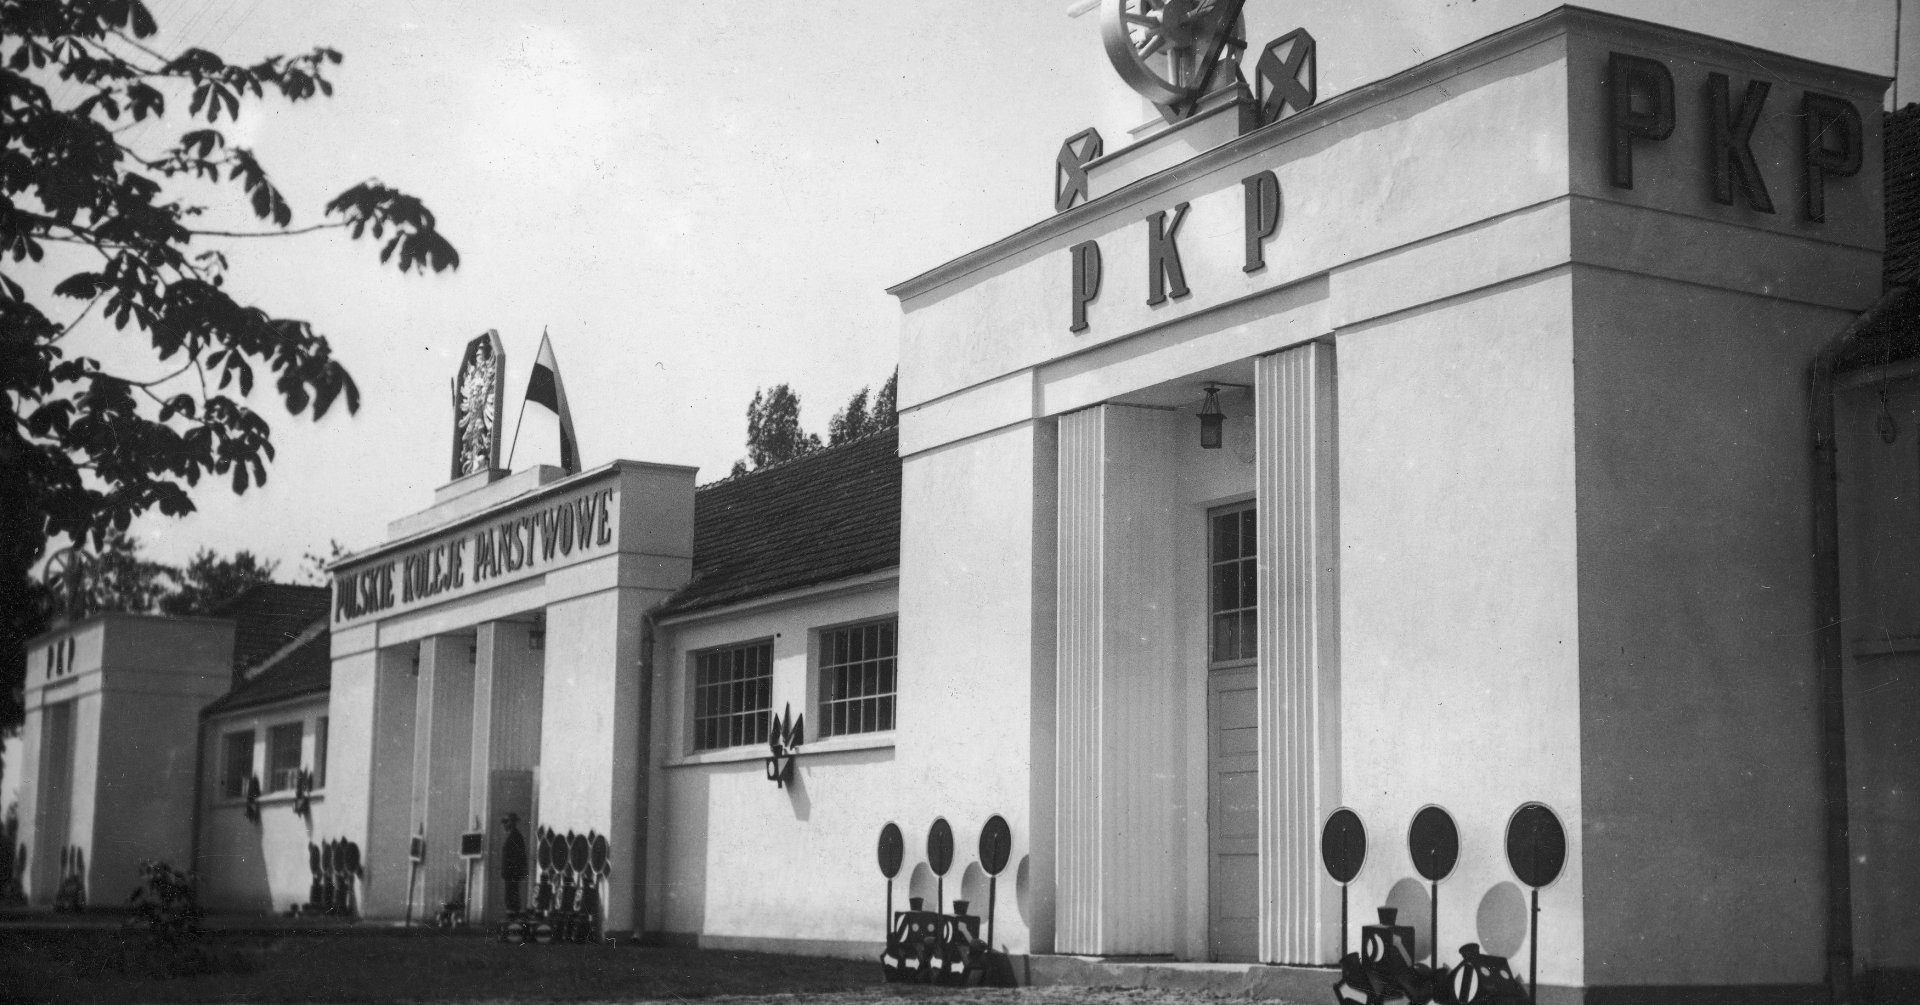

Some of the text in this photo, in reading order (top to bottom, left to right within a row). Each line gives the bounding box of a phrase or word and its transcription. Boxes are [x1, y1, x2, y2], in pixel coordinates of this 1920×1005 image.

[1608, 50, 1864, 224] PKP
[1069, 169, 1281, 333] PKP
[333, 487, 613, 623] POLSKIE KOLEJE PAŃSTWOWE
[46, 636, 76, 680] PKP
